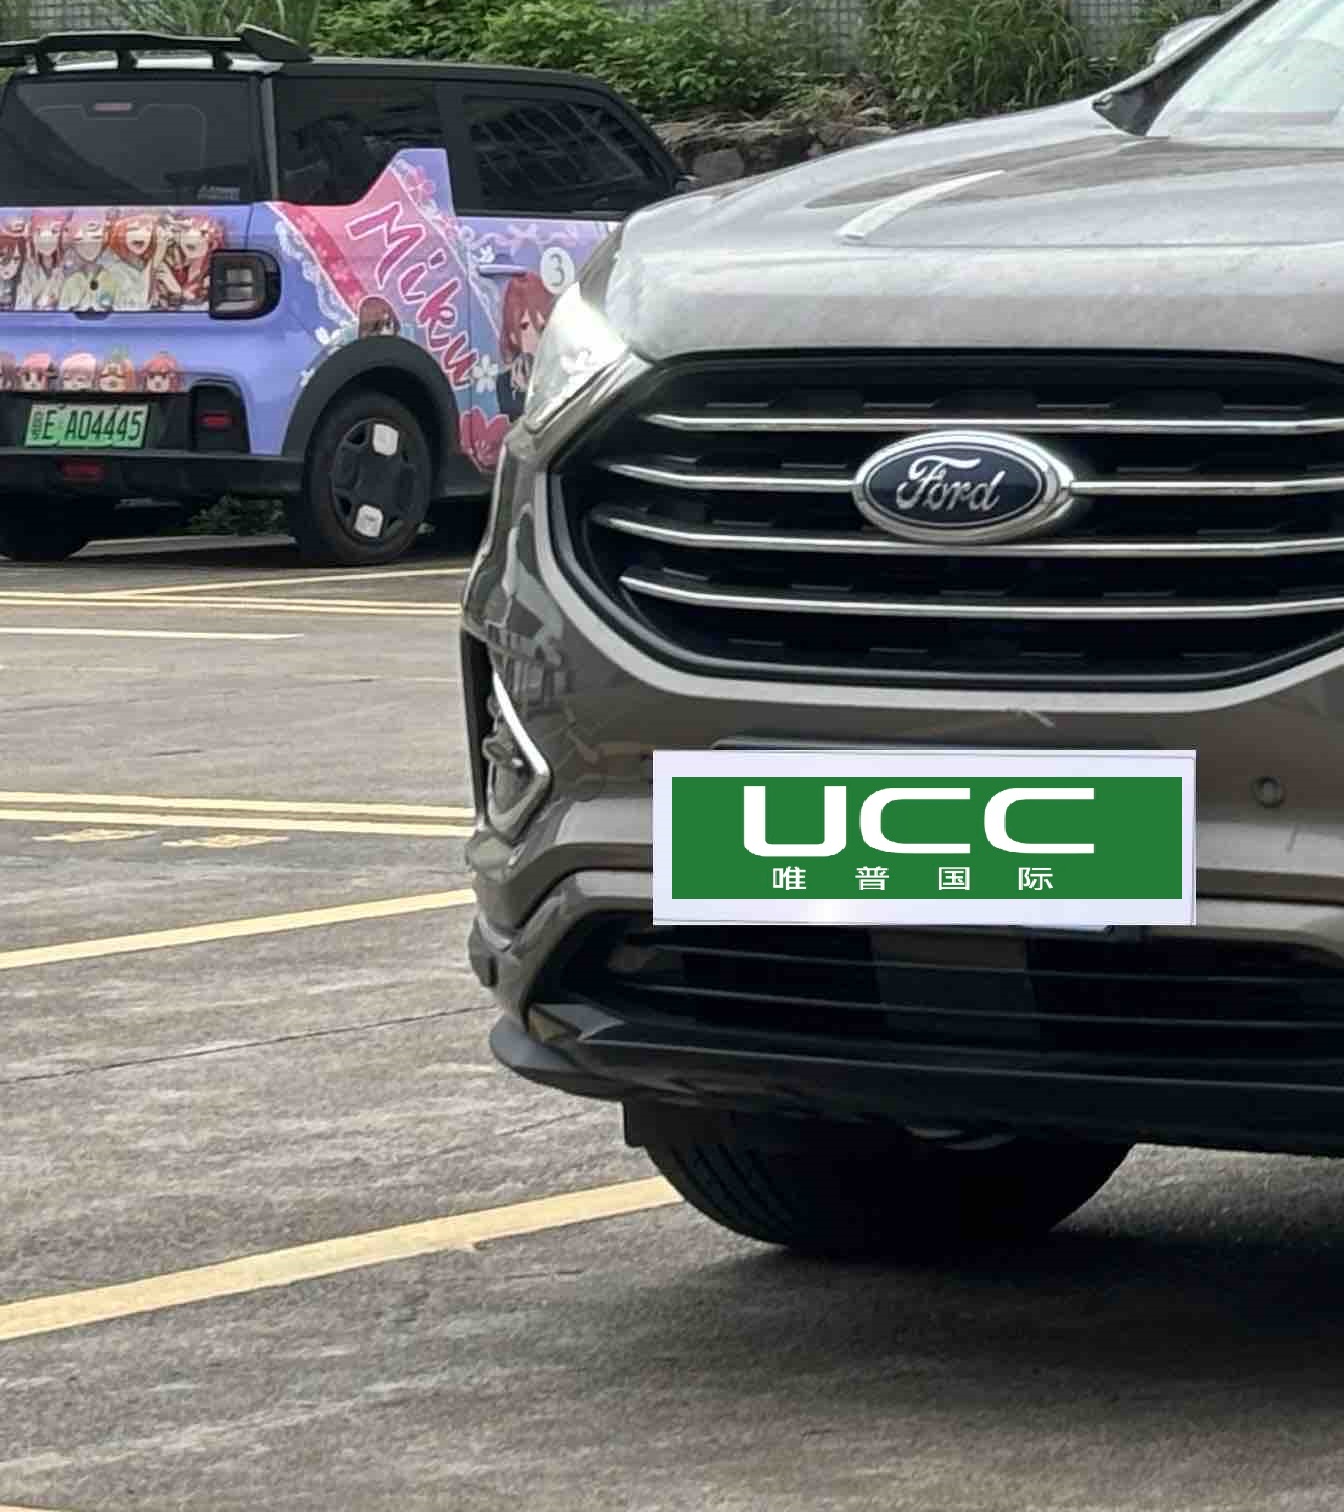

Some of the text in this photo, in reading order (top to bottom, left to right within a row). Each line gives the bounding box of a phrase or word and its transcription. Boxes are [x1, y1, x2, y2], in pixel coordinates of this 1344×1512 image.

[345, 202, 480, 390] Miku
[551, 252, 568, 289] 3
[896, 454, 1006, 511] Ford
